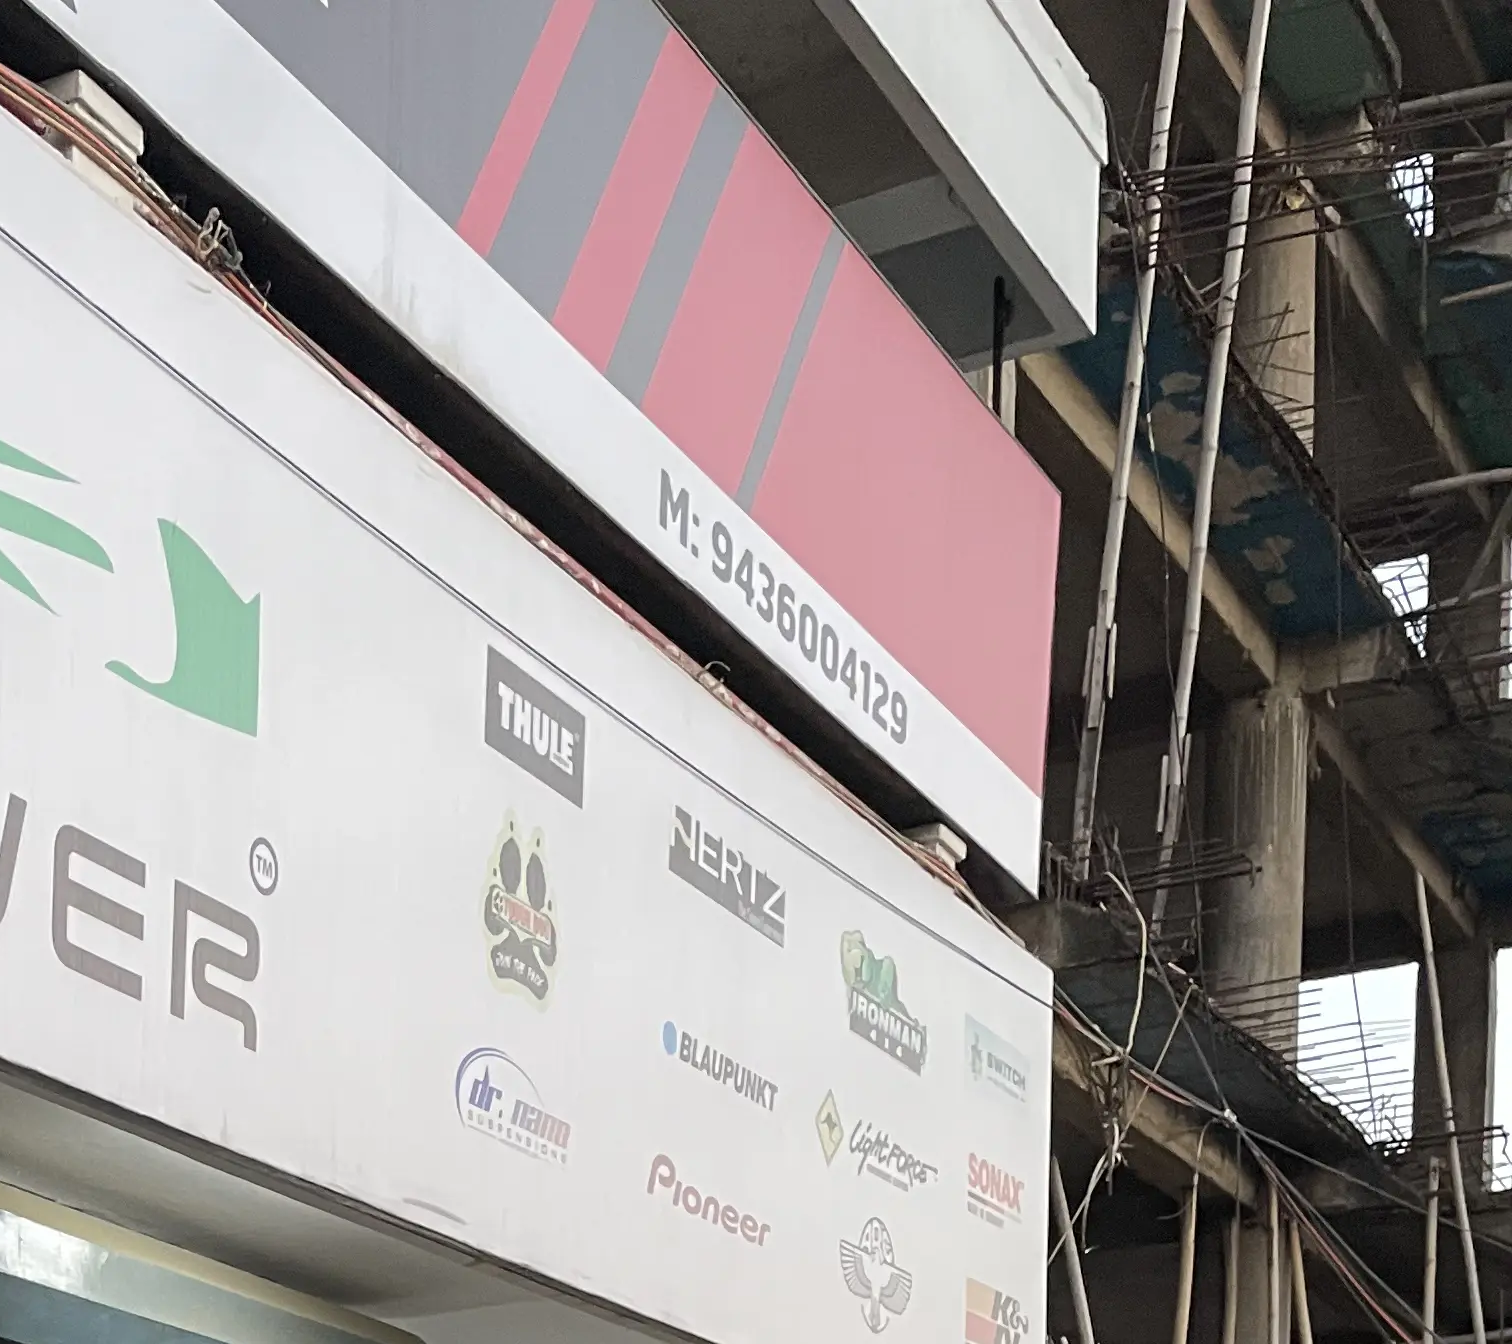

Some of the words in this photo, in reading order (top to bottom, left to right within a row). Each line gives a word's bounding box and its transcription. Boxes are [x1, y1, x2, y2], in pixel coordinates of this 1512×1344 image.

[659, 467, 700, 559] M:
[711, 520, 908, 745] 9436004129
[498, 680, 574, 776] THULE
[670, 803, 787, 925] HERTZ
[679, 1031, 779, 1111] BLAUPUNKT
[647, 1153, 772, 1247] Pioneer
[968, 1152, 1025, 1214] SONAX
